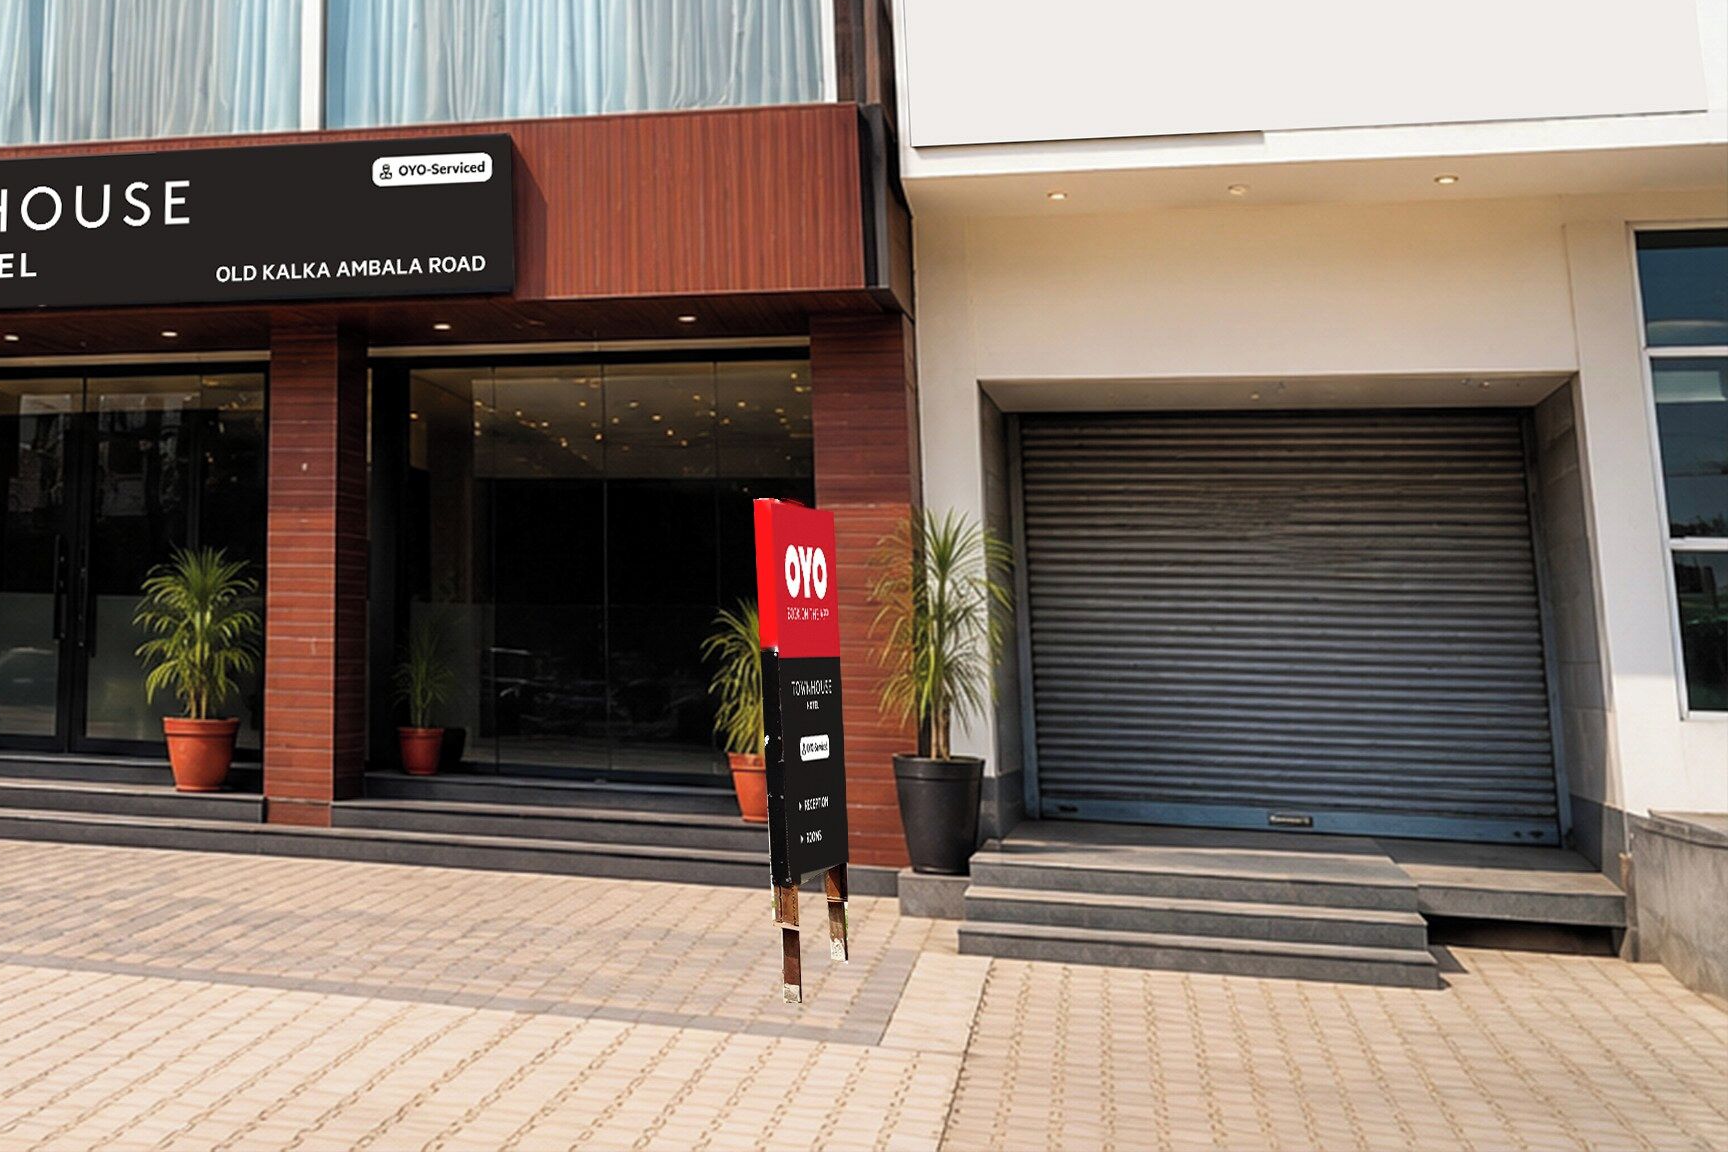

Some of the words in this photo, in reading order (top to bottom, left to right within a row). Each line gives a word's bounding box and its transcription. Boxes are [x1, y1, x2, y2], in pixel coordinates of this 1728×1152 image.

[397, 160, 486, 177] OYO-Serviced
[215, 265, 257, 283] OLD
[262, 261, 331, 281] KALKA
[336, 257, 423, 278] AMBALA
[428, 255, 486, 274] ROAD
[784, 544, 828, 600] OYO
[791, 680, 832, 696] TOWNHOUSE
[804, 796, 829, 811] RECEPTION
